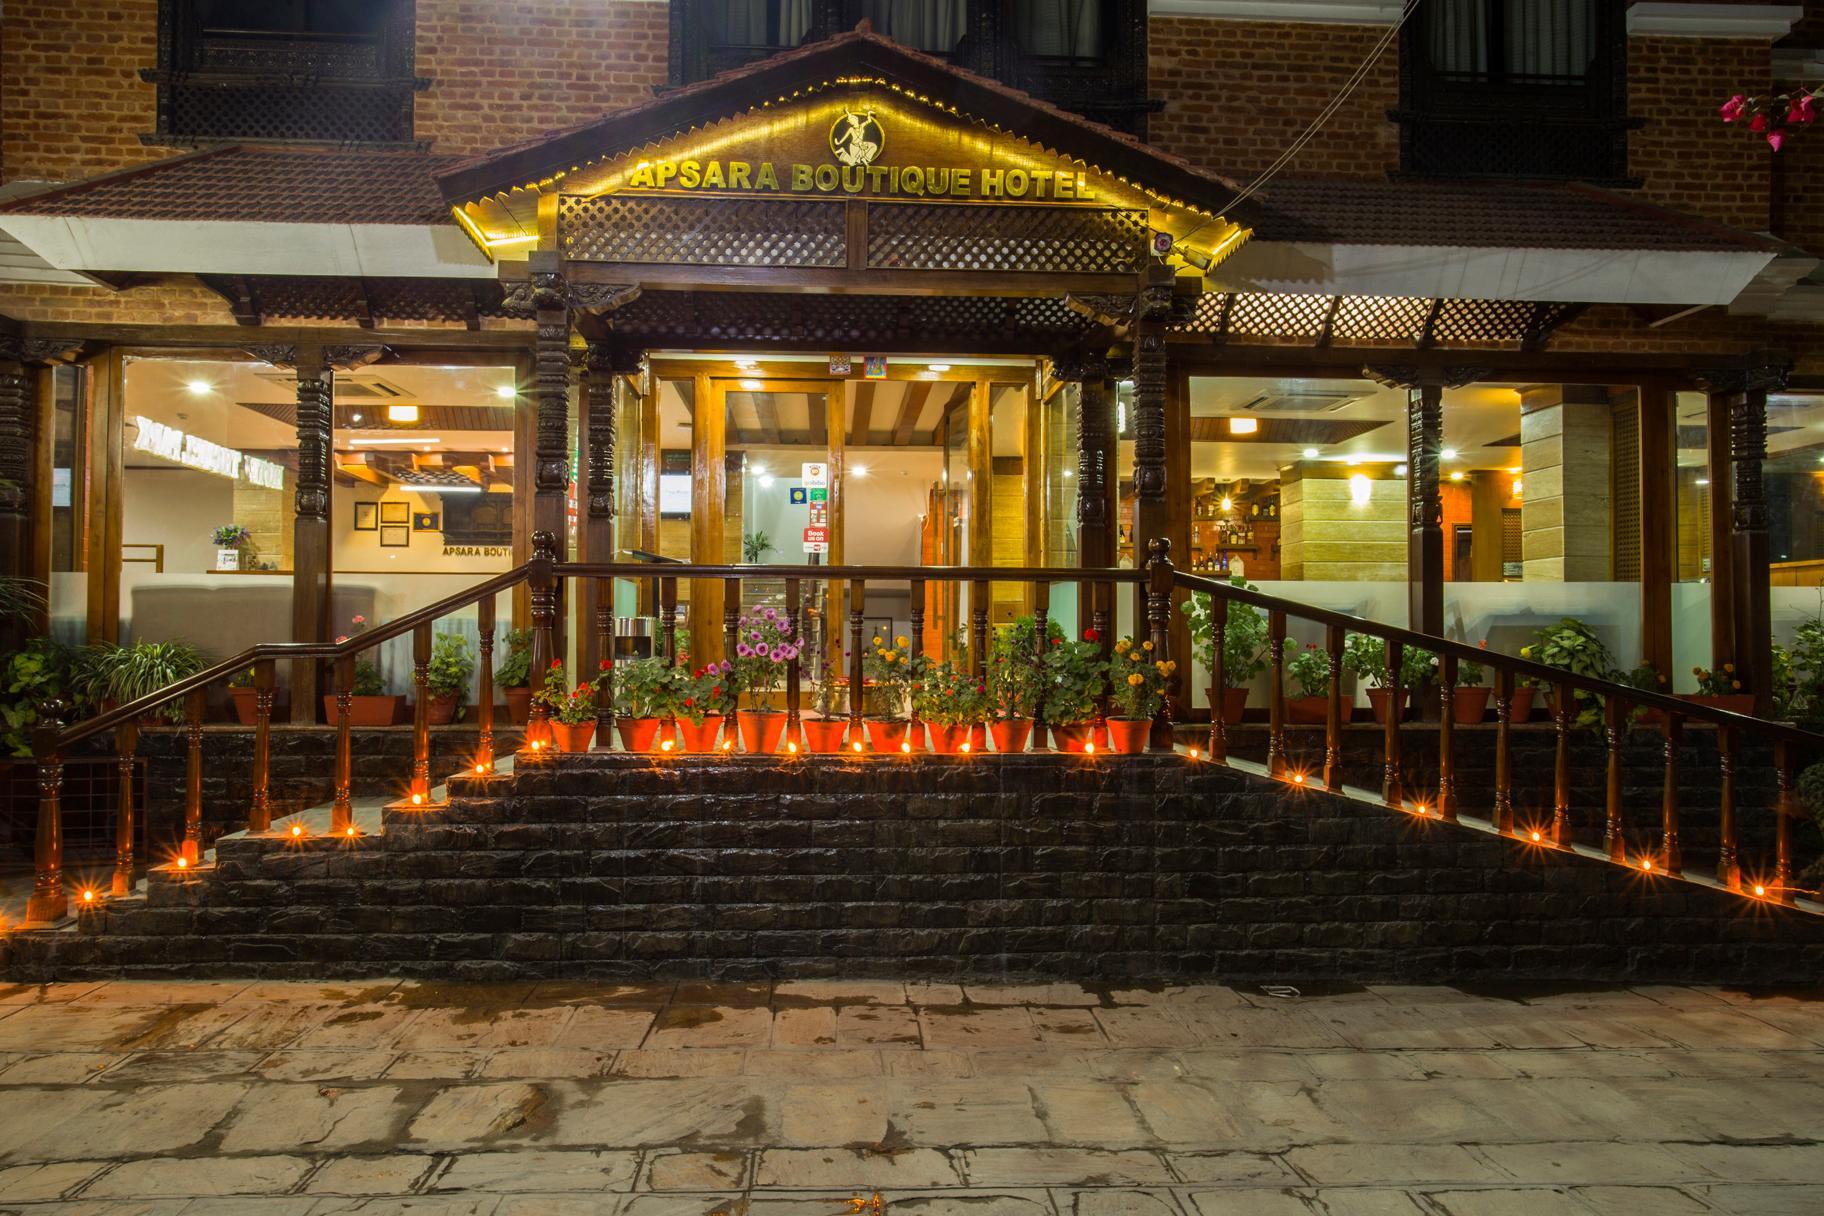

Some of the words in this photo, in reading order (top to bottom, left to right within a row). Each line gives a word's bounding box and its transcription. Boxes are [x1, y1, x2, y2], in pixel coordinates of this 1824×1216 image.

[629, 159, 780, 190] APSARA
[791, 163, 971, 197] BOUTIQUE
[981, 168, 1096, 199] HOTEL
[442, 547, 481, 556] APSARA
